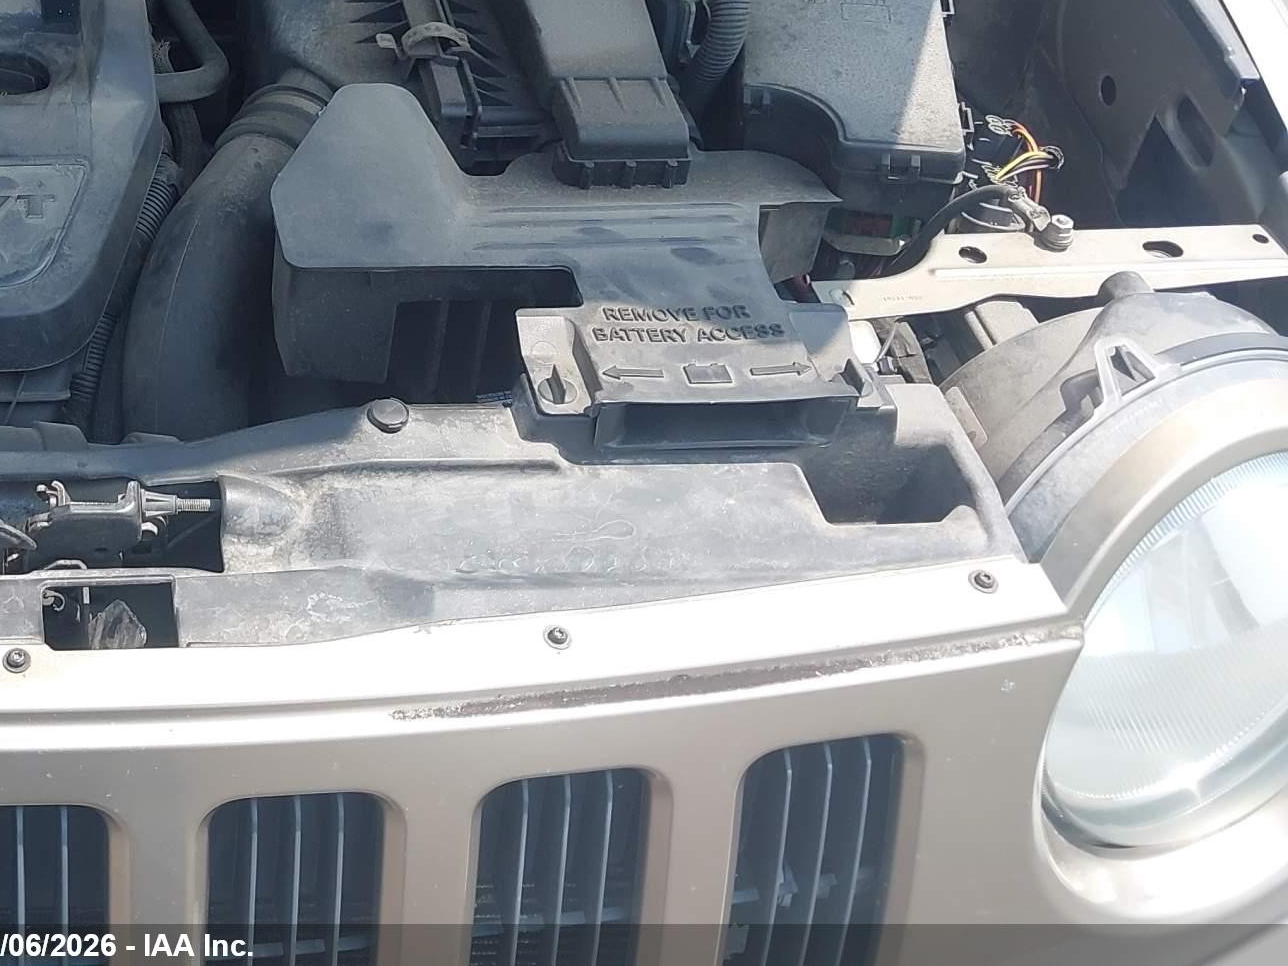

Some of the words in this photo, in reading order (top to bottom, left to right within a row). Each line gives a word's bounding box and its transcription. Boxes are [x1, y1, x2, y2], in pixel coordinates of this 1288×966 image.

[601, 307, 696, 322] REMOVE
[702, 305, 751, 321] FOR
[591, 327, 688, 343] BATTERY
[696, 323, 785, 343] ACCESS
